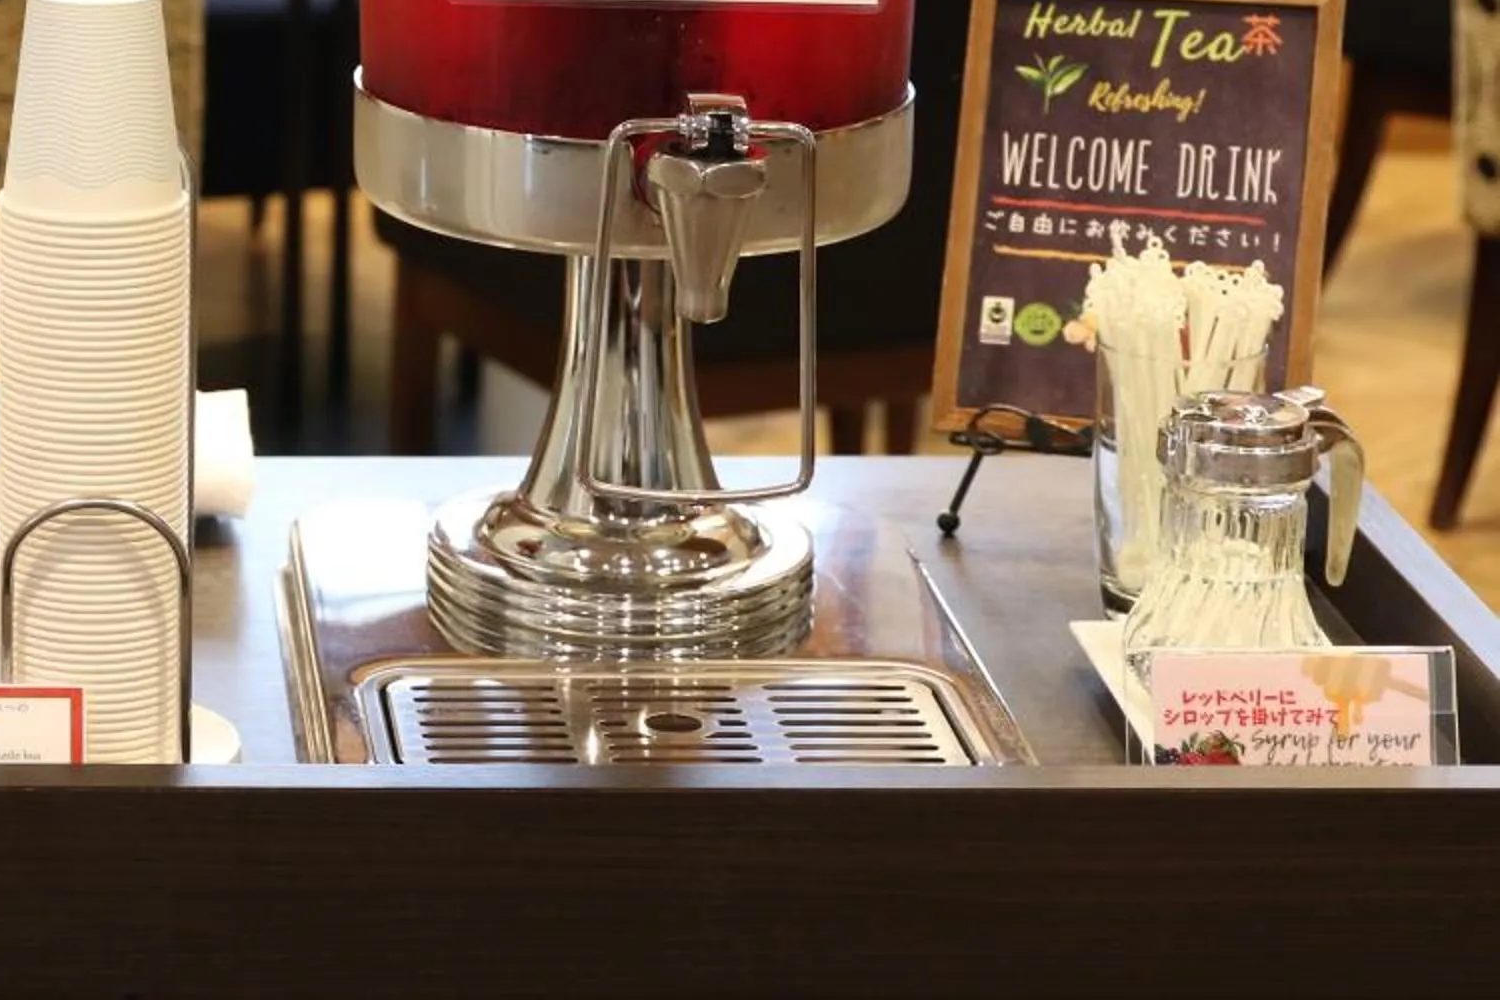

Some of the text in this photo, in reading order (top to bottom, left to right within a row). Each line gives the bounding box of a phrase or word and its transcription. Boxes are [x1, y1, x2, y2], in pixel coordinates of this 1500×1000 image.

[1023, 2, 1246, 69] Herbal Tea
[1240, 13, 1284, 57] 茶
[1087, 77, 1208, 123] Refreshing!
[1000, 131, 1284, 206] WELCOME DRINK
[1163, 707, 1341, 727] シロップを掛けてみて
[1251, 728, 1320, 762] Syrup
[1327, 728, 1361, 766] for
[1367, 732, 1422, 762] your
